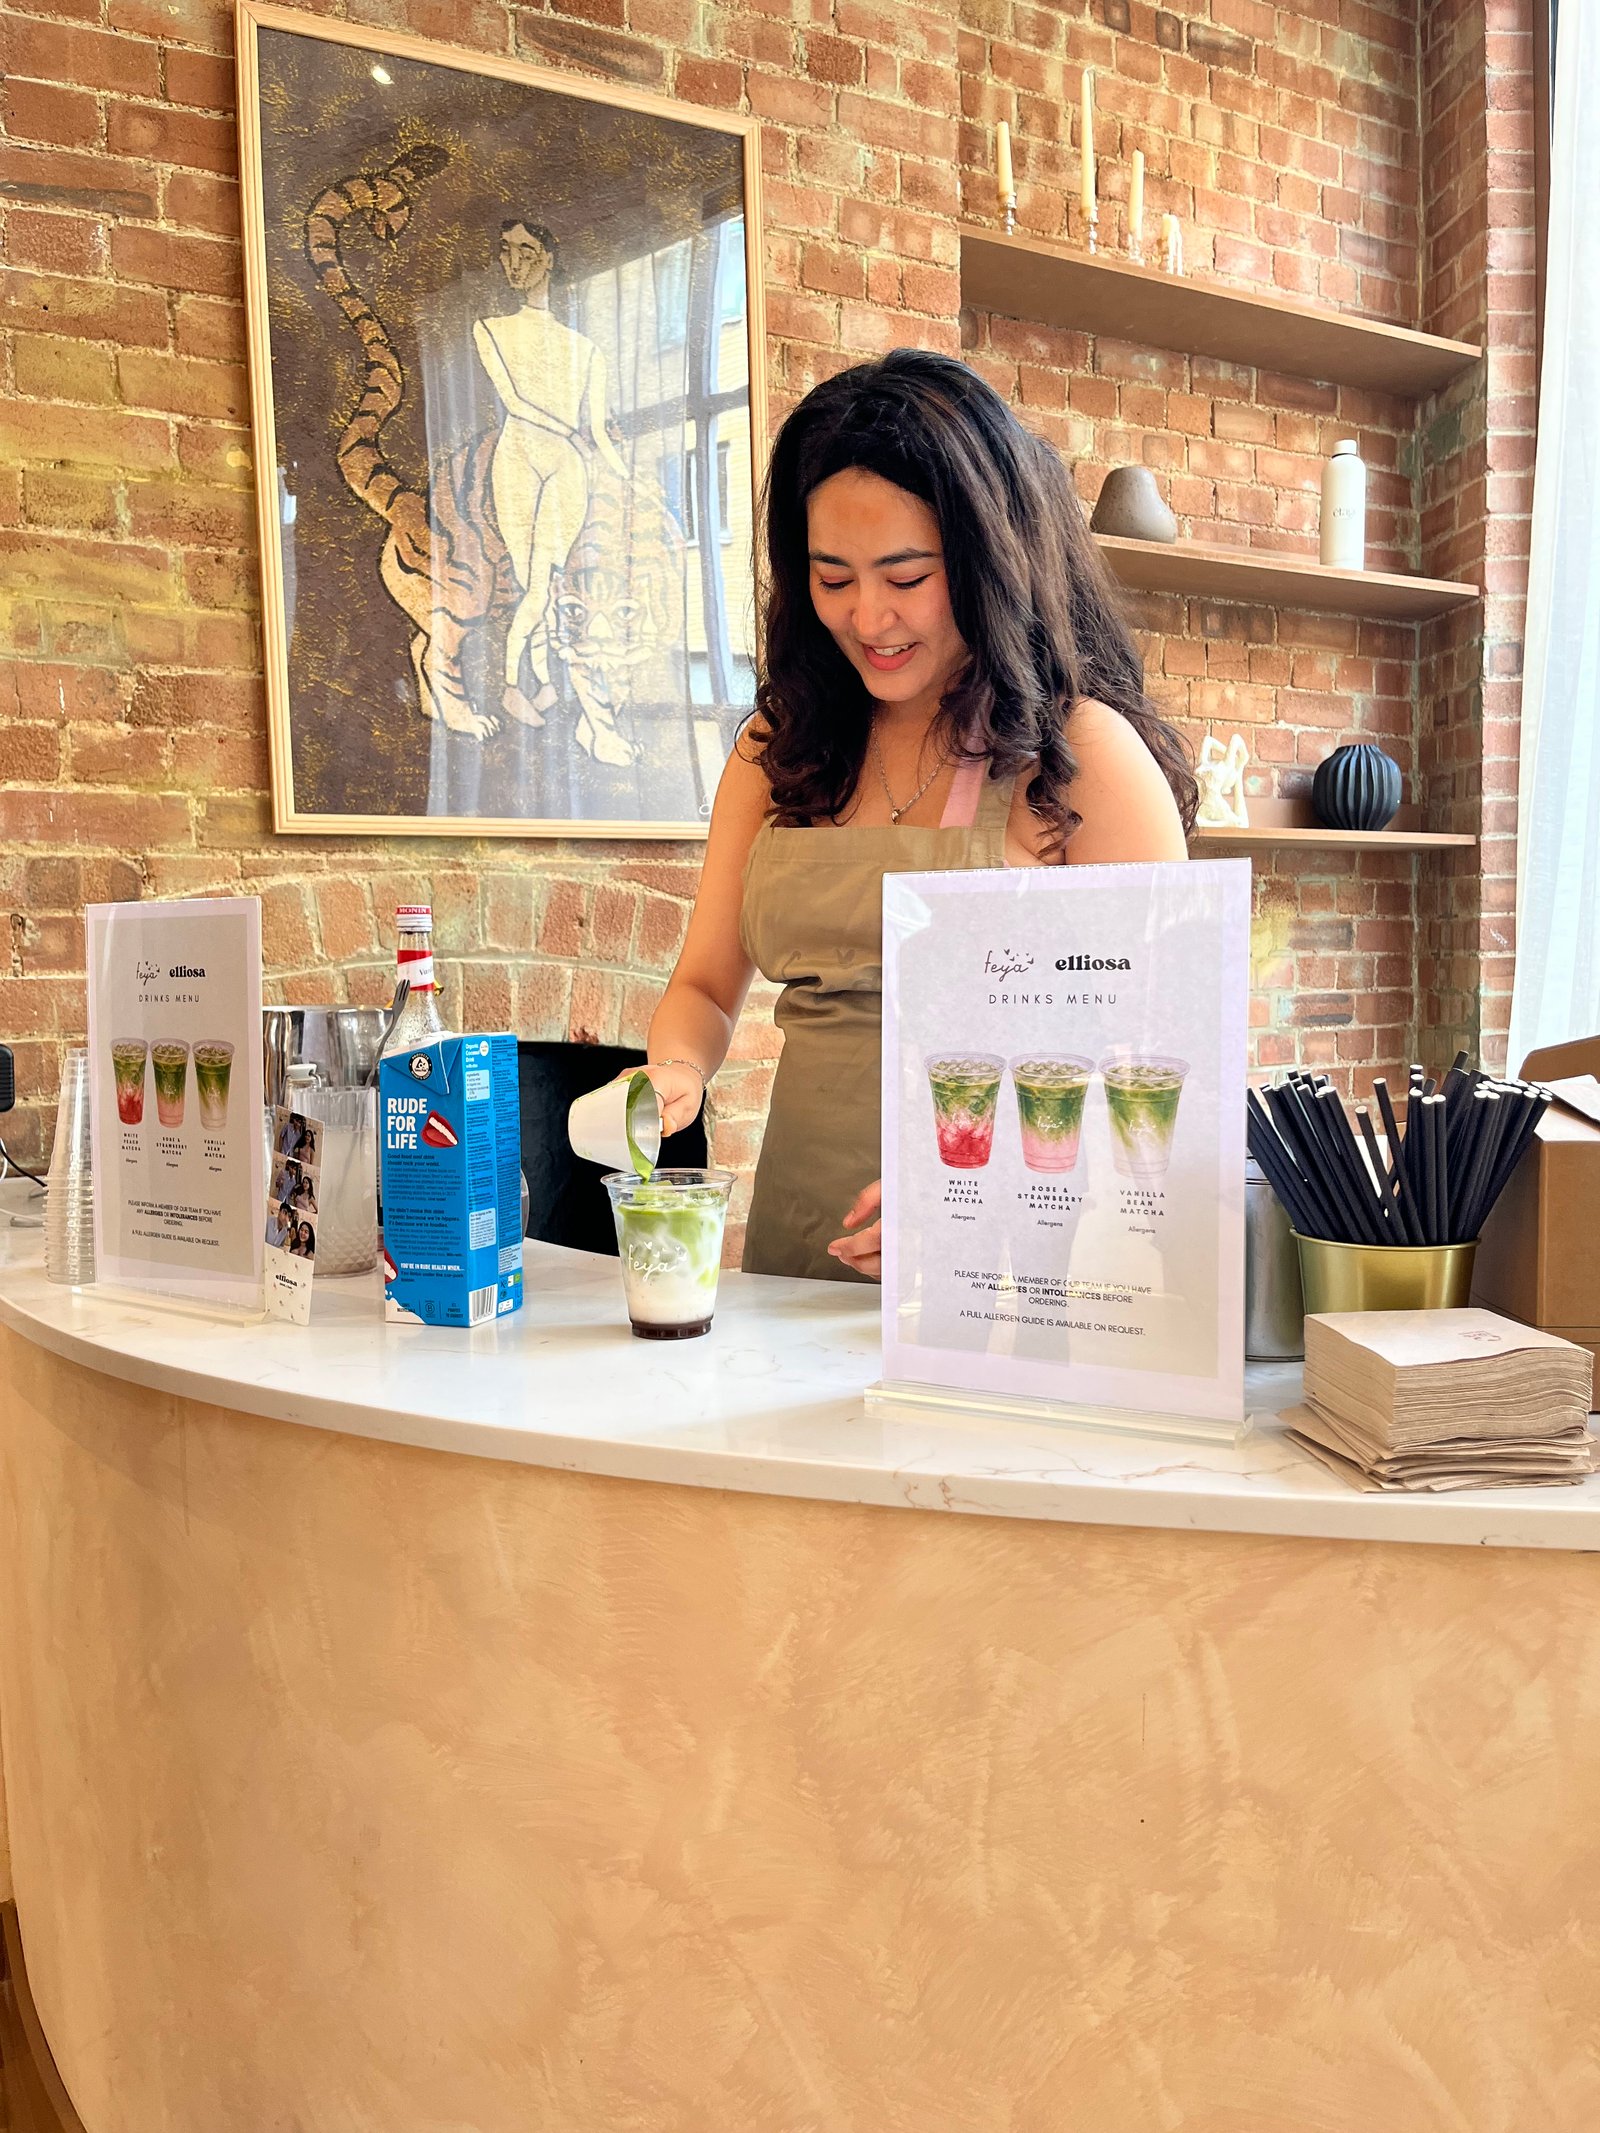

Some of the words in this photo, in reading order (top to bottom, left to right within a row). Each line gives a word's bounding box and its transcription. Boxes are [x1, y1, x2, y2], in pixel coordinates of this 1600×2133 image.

[984, 950, 1029, 982] feya
[1055, 954, 1132, 971] elliosa
[169, 965, 206, 978] elliosa
[138, 994, 170, 1003] DRINKS
[175, 994, 200, 1003] MENU
[988, 994, 1054, 1005] DRINKS
[1066, 994, 1118, 1005] MENU
[387, 1097, 428, 1114] RUDE
[387, 1115, 416, 1132] FOR
[387, 1133, 418, 1150] LIFE
[948, 1179, 978, 1187] WHITE
[948, 1188, 979, 1196] PEACH
[1031, 1185, 1057, 1193] ROSE
[1119, 1189, 1165, 1199] VANILLA
[943, 1196, 983, 1205] MATCHA
[1017, 1193, 1083, 1203] STRAWBERRY
[1126, 1199, 1153, 1207] BEAN
[1028, 1203, 1071, 1212] MATCHA
[1119, 1207, 1165, 1217] MATCHA
[950, 1213, 976, 1222] Allergens
[1036, 1219, 1064, 1228] Allergens
[628, 1243, 677, 1281] feya
[954, 1269, 980, 1280] PLEASE
[1017, 1275, 1049, 1286] MEMBER
[1050, 1278, 1062, 1287] OF
[970, 1281, 986, 1290] ANY
[1028, 1286, 1041, 1295] OR
[1102, 1293, 1134, 1304] BEFORE
[1028, 1296, 1070, 1308] ORDERING.
[959, 1309, 966, 1317] A
[966, 1310, 982, 1319] FULL
[983, 1312, 1020, 1323] ALLERGEN
[1021, 1316, 1045, 1326] GUIDE
[1046, 1318, 1054, 1327] IS
[1055, 1319, 1092, 1330] AVAILABLE
[1093, 1323, 1107, 1332] ON
[1107, 1324, 1147, 1336] REQUEST.
